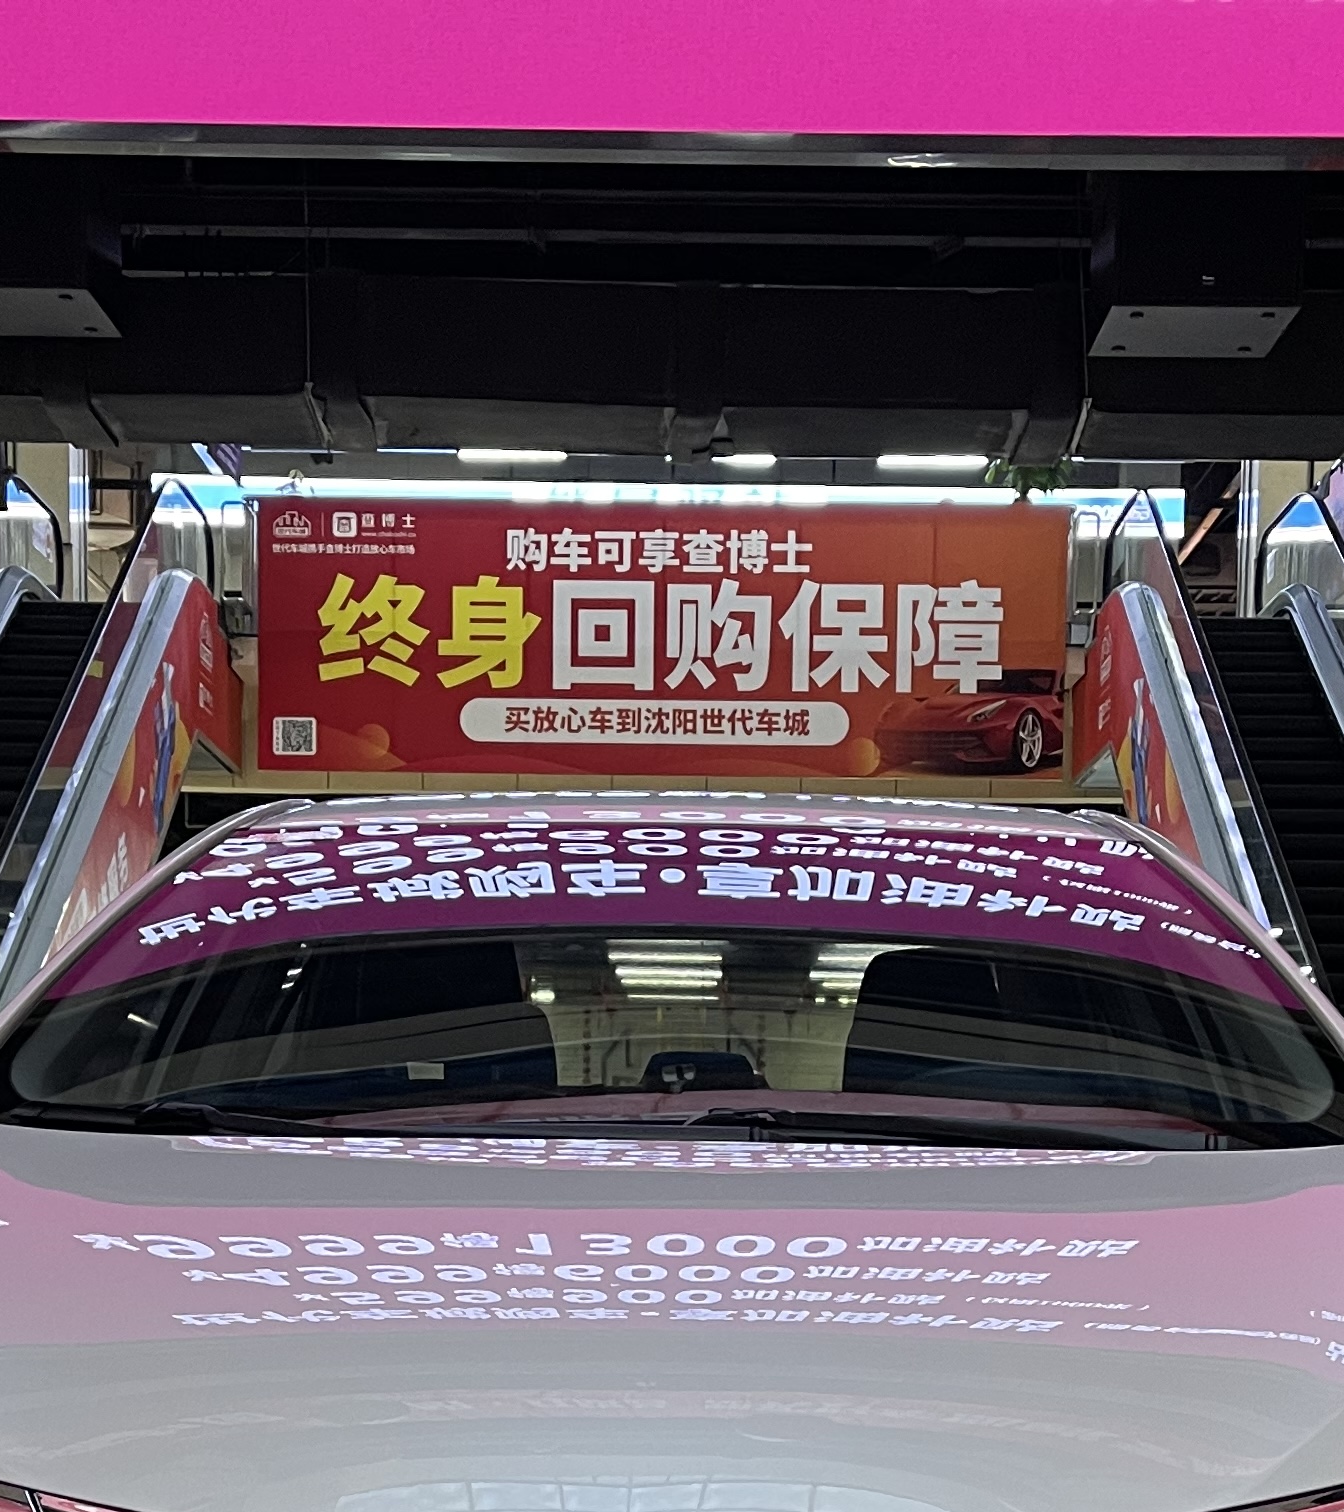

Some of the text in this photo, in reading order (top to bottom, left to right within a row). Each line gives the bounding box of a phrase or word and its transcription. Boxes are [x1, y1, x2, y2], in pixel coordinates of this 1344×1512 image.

[361, 513, 416, 529] 查博士
[505, 527, 813, 574] 购车可享查博士
[317, 572, 1005, 695] 终身回购保障
[504, 705, 811, 737] 买放心车到沈阳世代车城
